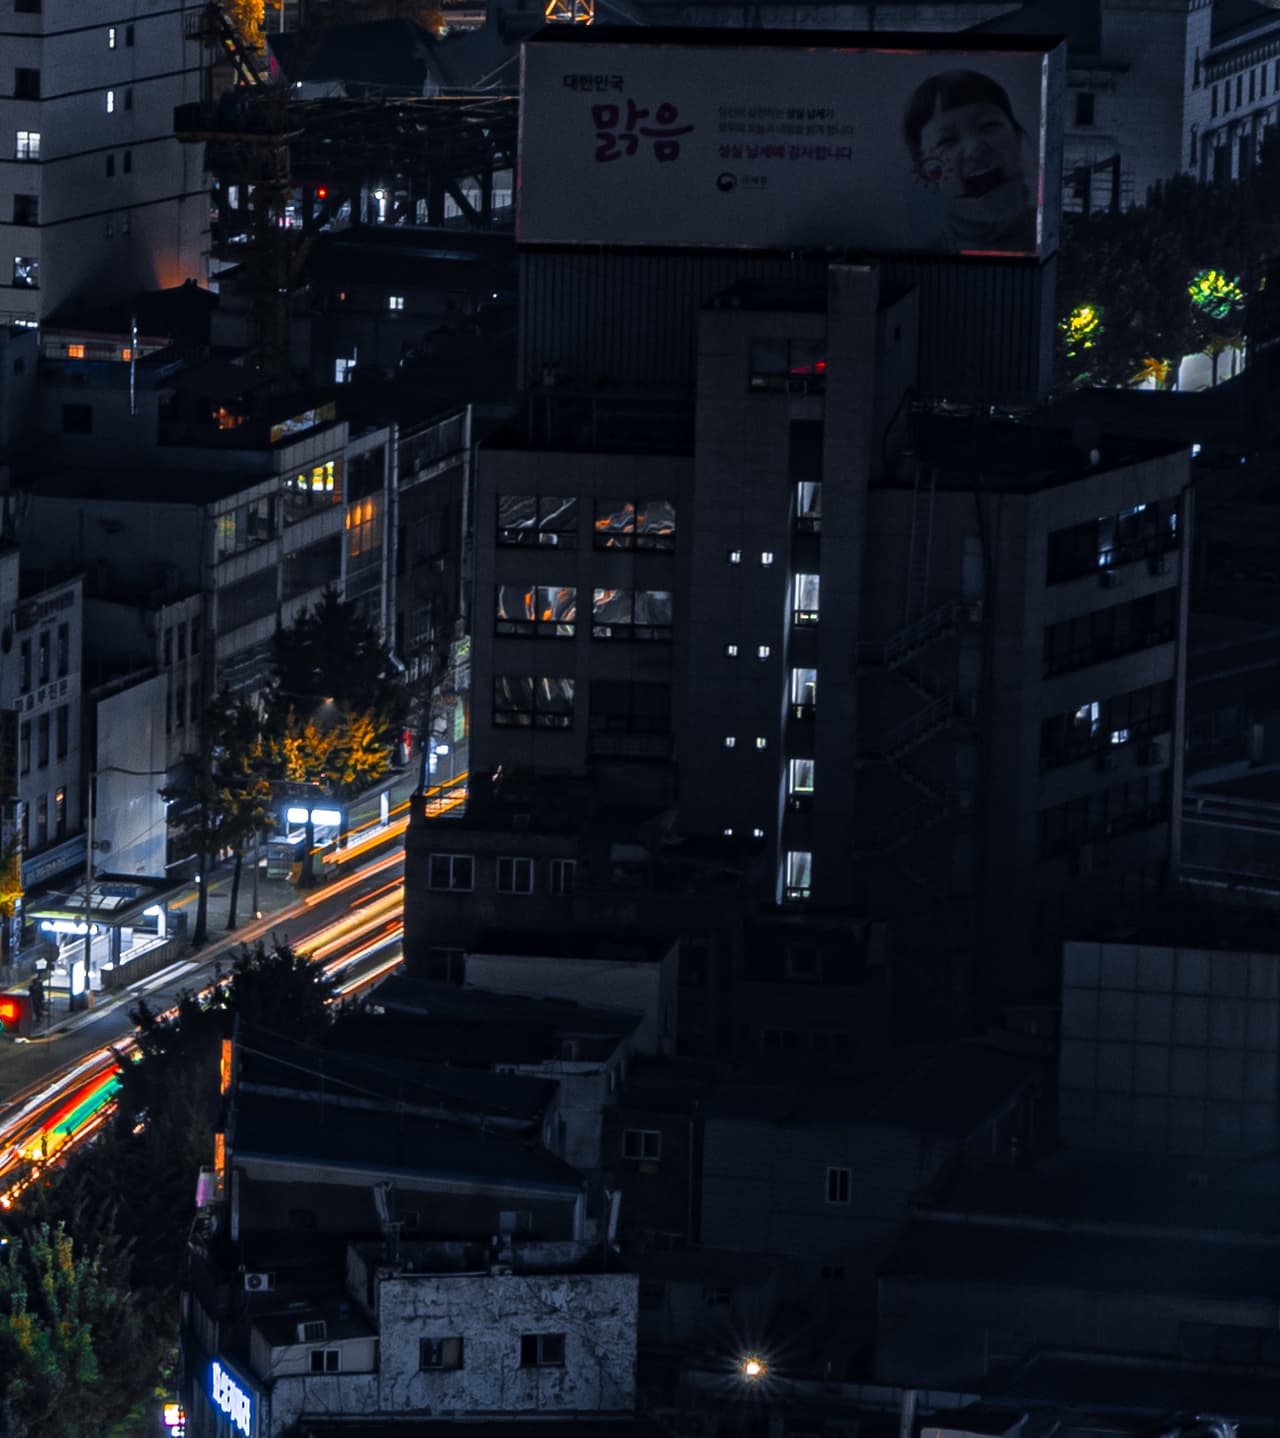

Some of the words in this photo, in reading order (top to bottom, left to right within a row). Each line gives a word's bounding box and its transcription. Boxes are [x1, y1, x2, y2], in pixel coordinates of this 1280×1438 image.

[562, 74, 625, 92] 대한민국
[591, 98, 694, 162] 맑음
[788, 144, 853, 162] 감사합니다
